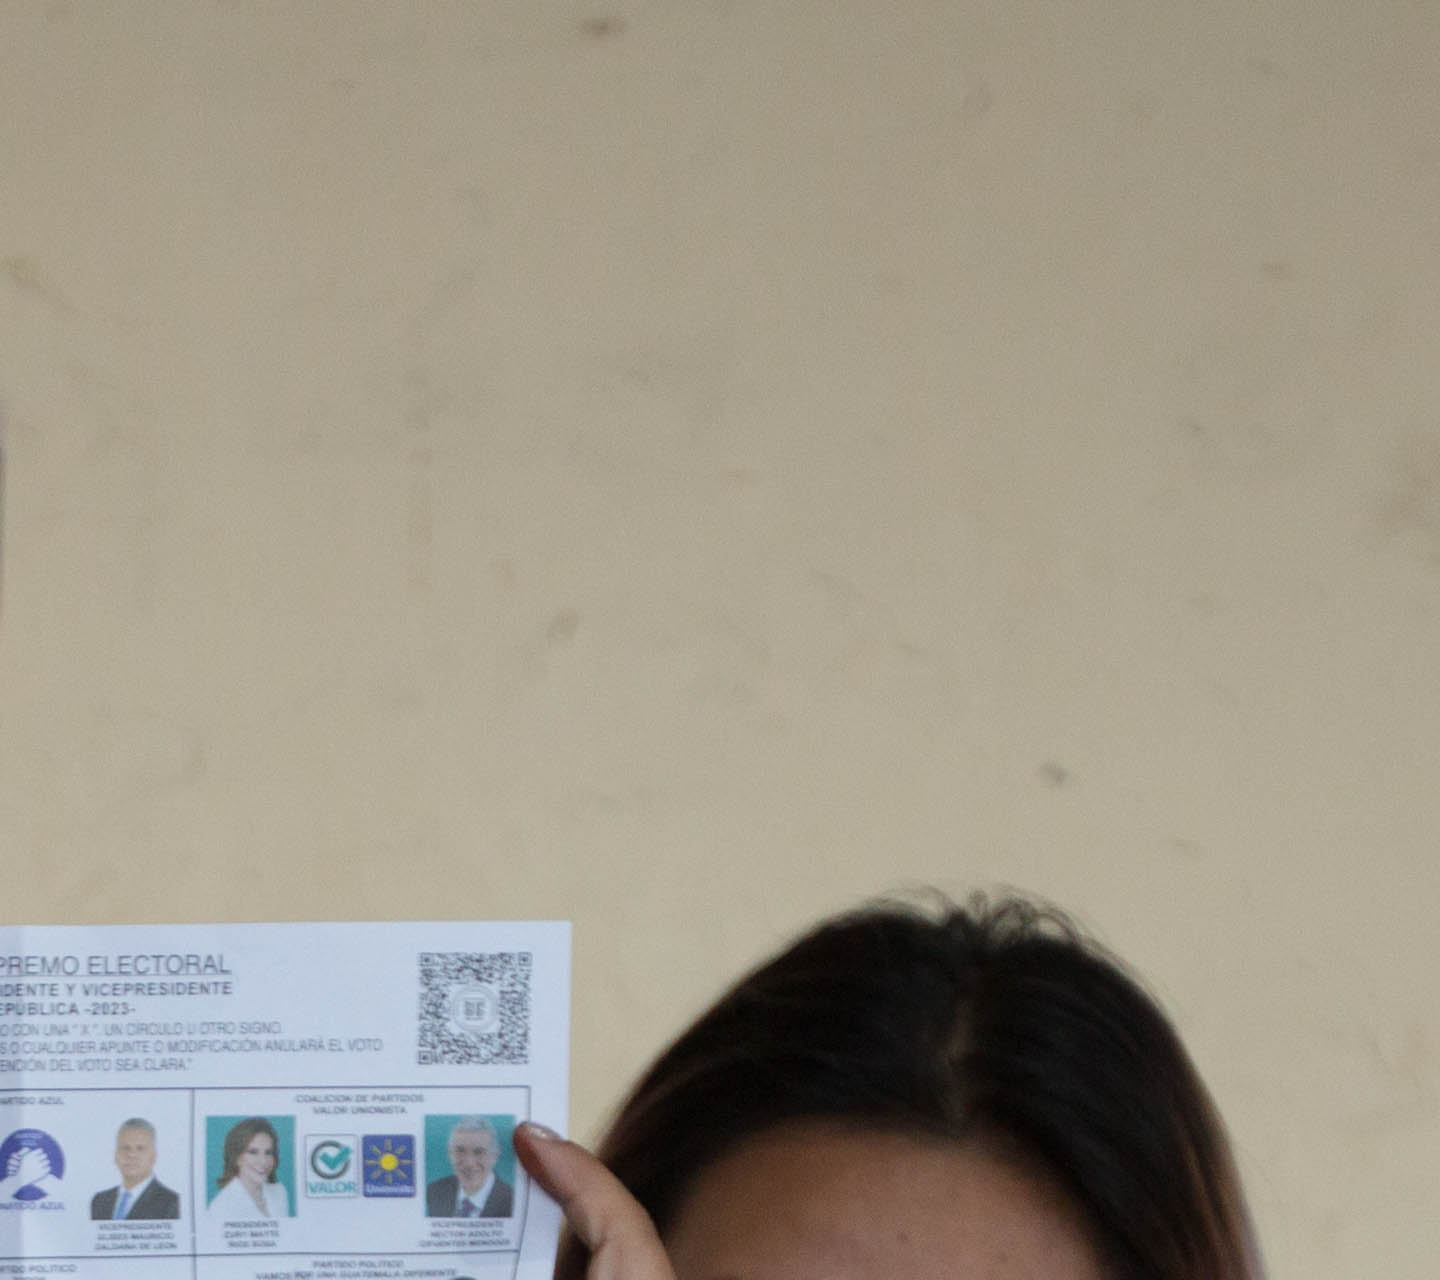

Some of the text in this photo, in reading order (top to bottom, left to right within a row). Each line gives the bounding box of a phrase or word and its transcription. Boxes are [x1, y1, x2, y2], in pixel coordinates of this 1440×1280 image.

[87, 953, 232, 975] ELECTORAL
[65, 983, 76, 996] Y
[82, 981, 232, 996] VICEPRESIDENTE
[84, 1002, 135, 1016] -2023-
[199, 1021, 236, 1035] OTRO
[348, 1038, 384, 1051] VOTO
[308, 1181, 356, 1194] VALOR
